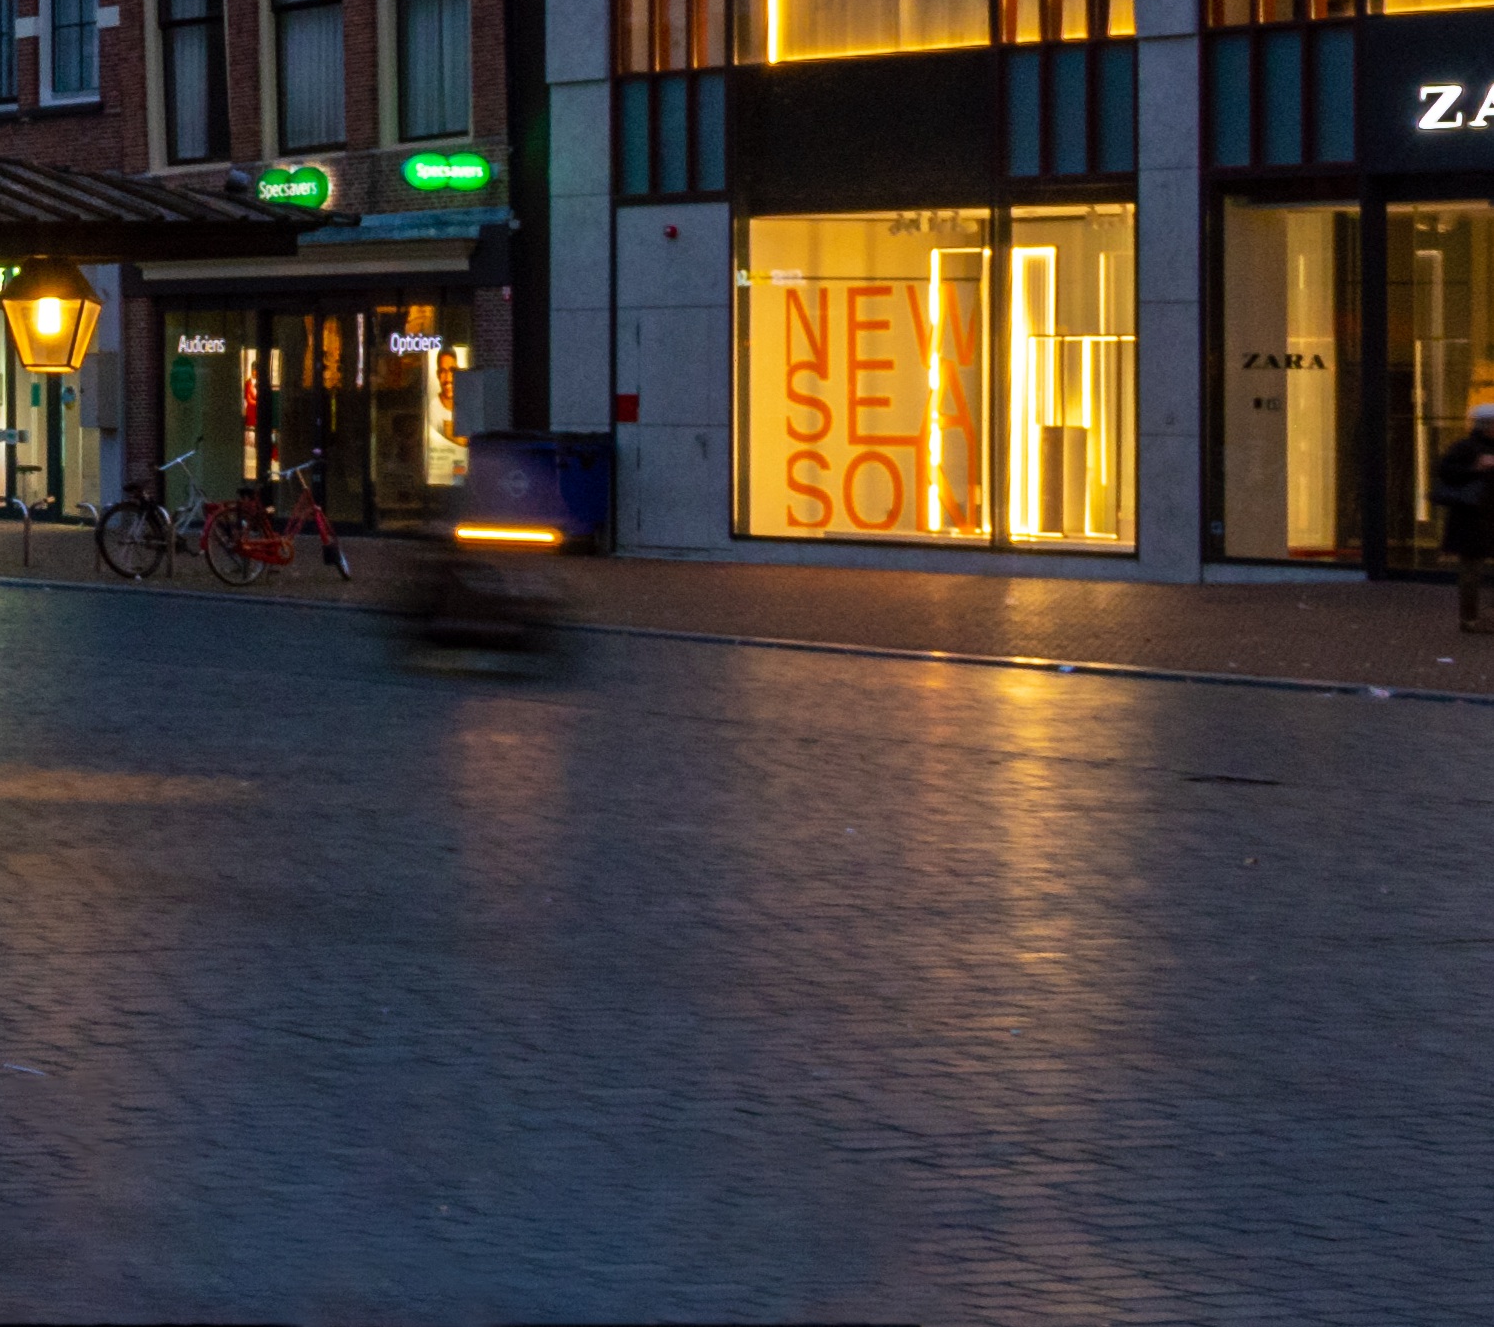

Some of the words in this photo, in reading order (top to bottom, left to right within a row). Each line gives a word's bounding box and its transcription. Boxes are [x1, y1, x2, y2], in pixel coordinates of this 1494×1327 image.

[415, 163, 484, 180] Specsavers
[258, 180, 318, 200] Specsavers
[785, 283, 978, 382] NEW
[177, 334, 226, 354] Audiciens
[390, 332, 442, 356] Opticiens
[1241, 351, 1328, 370] ZARA
